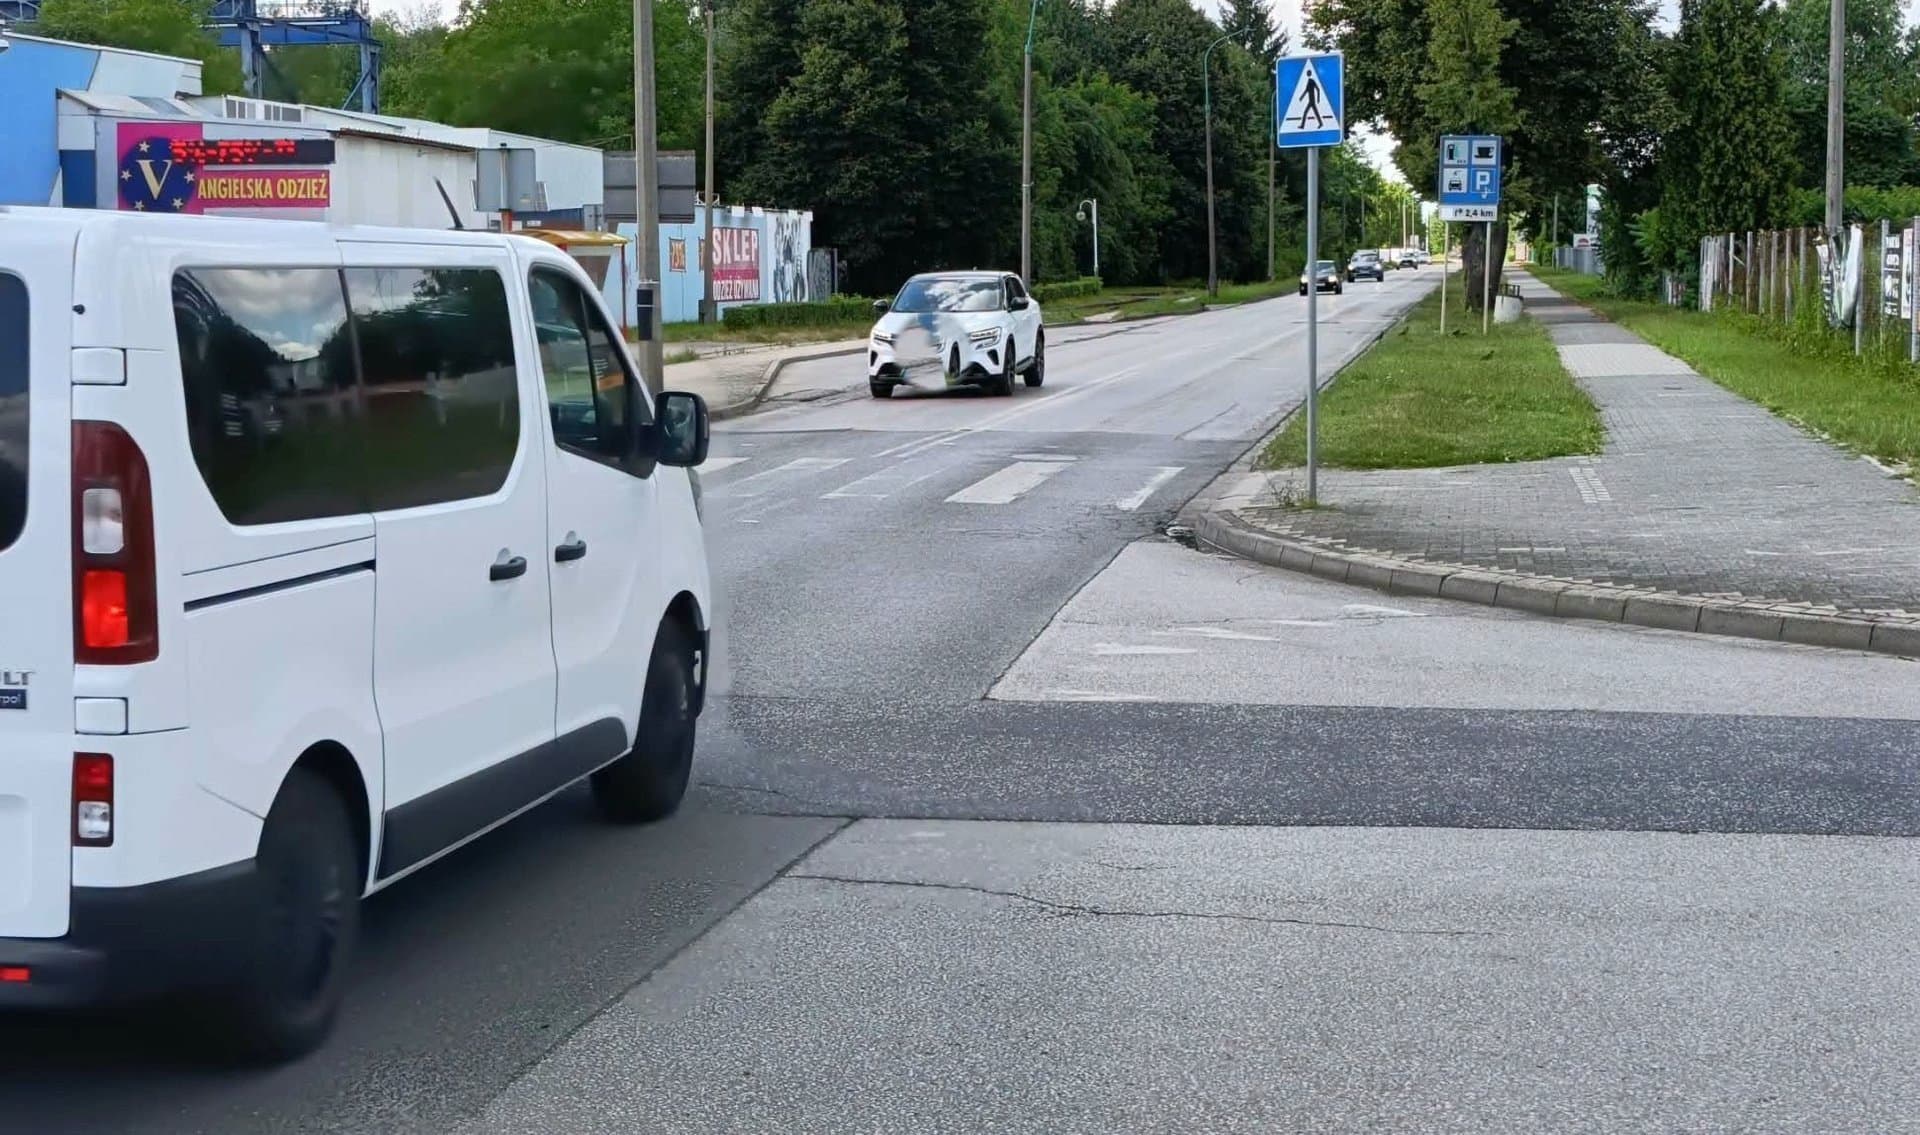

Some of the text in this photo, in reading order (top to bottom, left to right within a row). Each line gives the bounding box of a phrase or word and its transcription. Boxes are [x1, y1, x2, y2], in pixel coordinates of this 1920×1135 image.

[136, 160, 172, 200] V
[198, 173, 328, 199] ANGIELSKA ODZIEŻ
[1465, 207, 1494, 218] 2,4 km
[712, 228, 758, 265] SKLEP
[0, 672, 36, 686] LT
